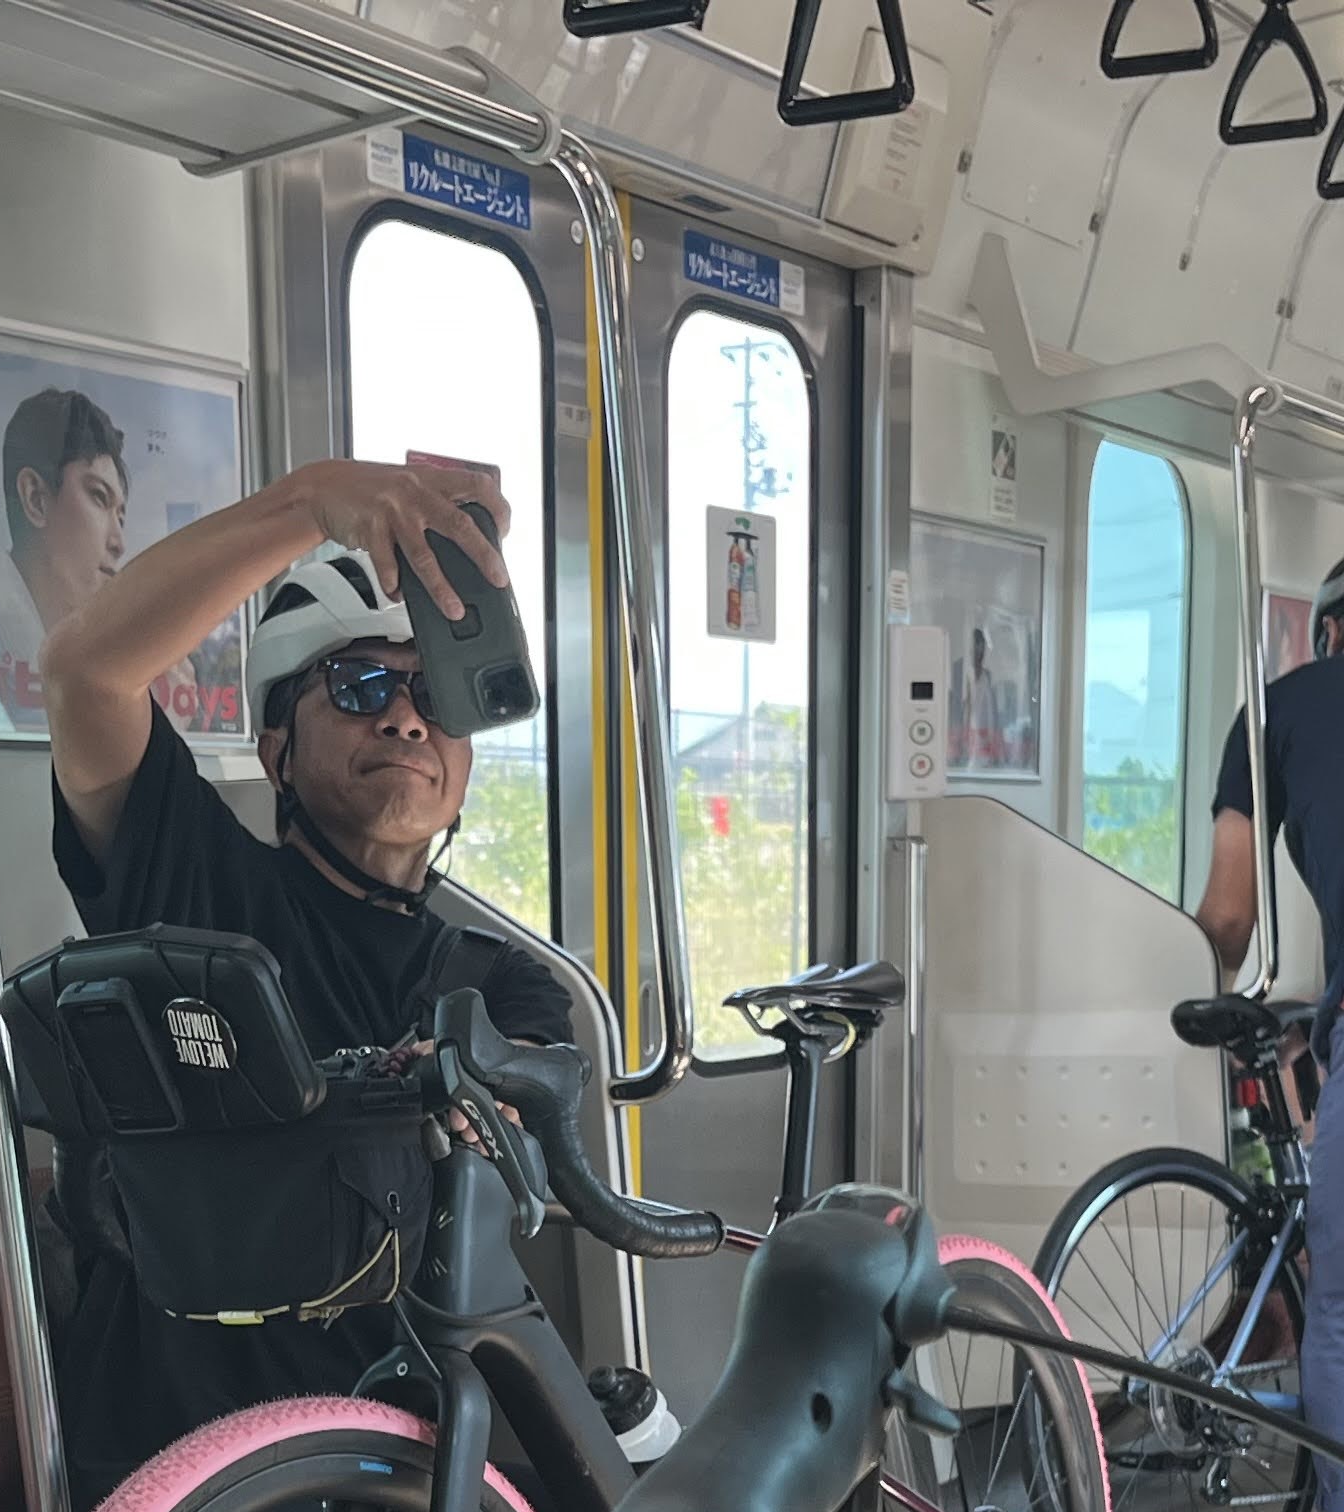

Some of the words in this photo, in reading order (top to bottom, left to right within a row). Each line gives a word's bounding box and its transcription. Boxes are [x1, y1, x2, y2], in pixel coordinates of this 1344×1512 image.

[167, 1009, 223, 1042] TOMATO
[173, 1037, 206, 1067] LOVE
[203, 1042, 230, 1069] WE
[461, 1099, 504, 1160] GRX
